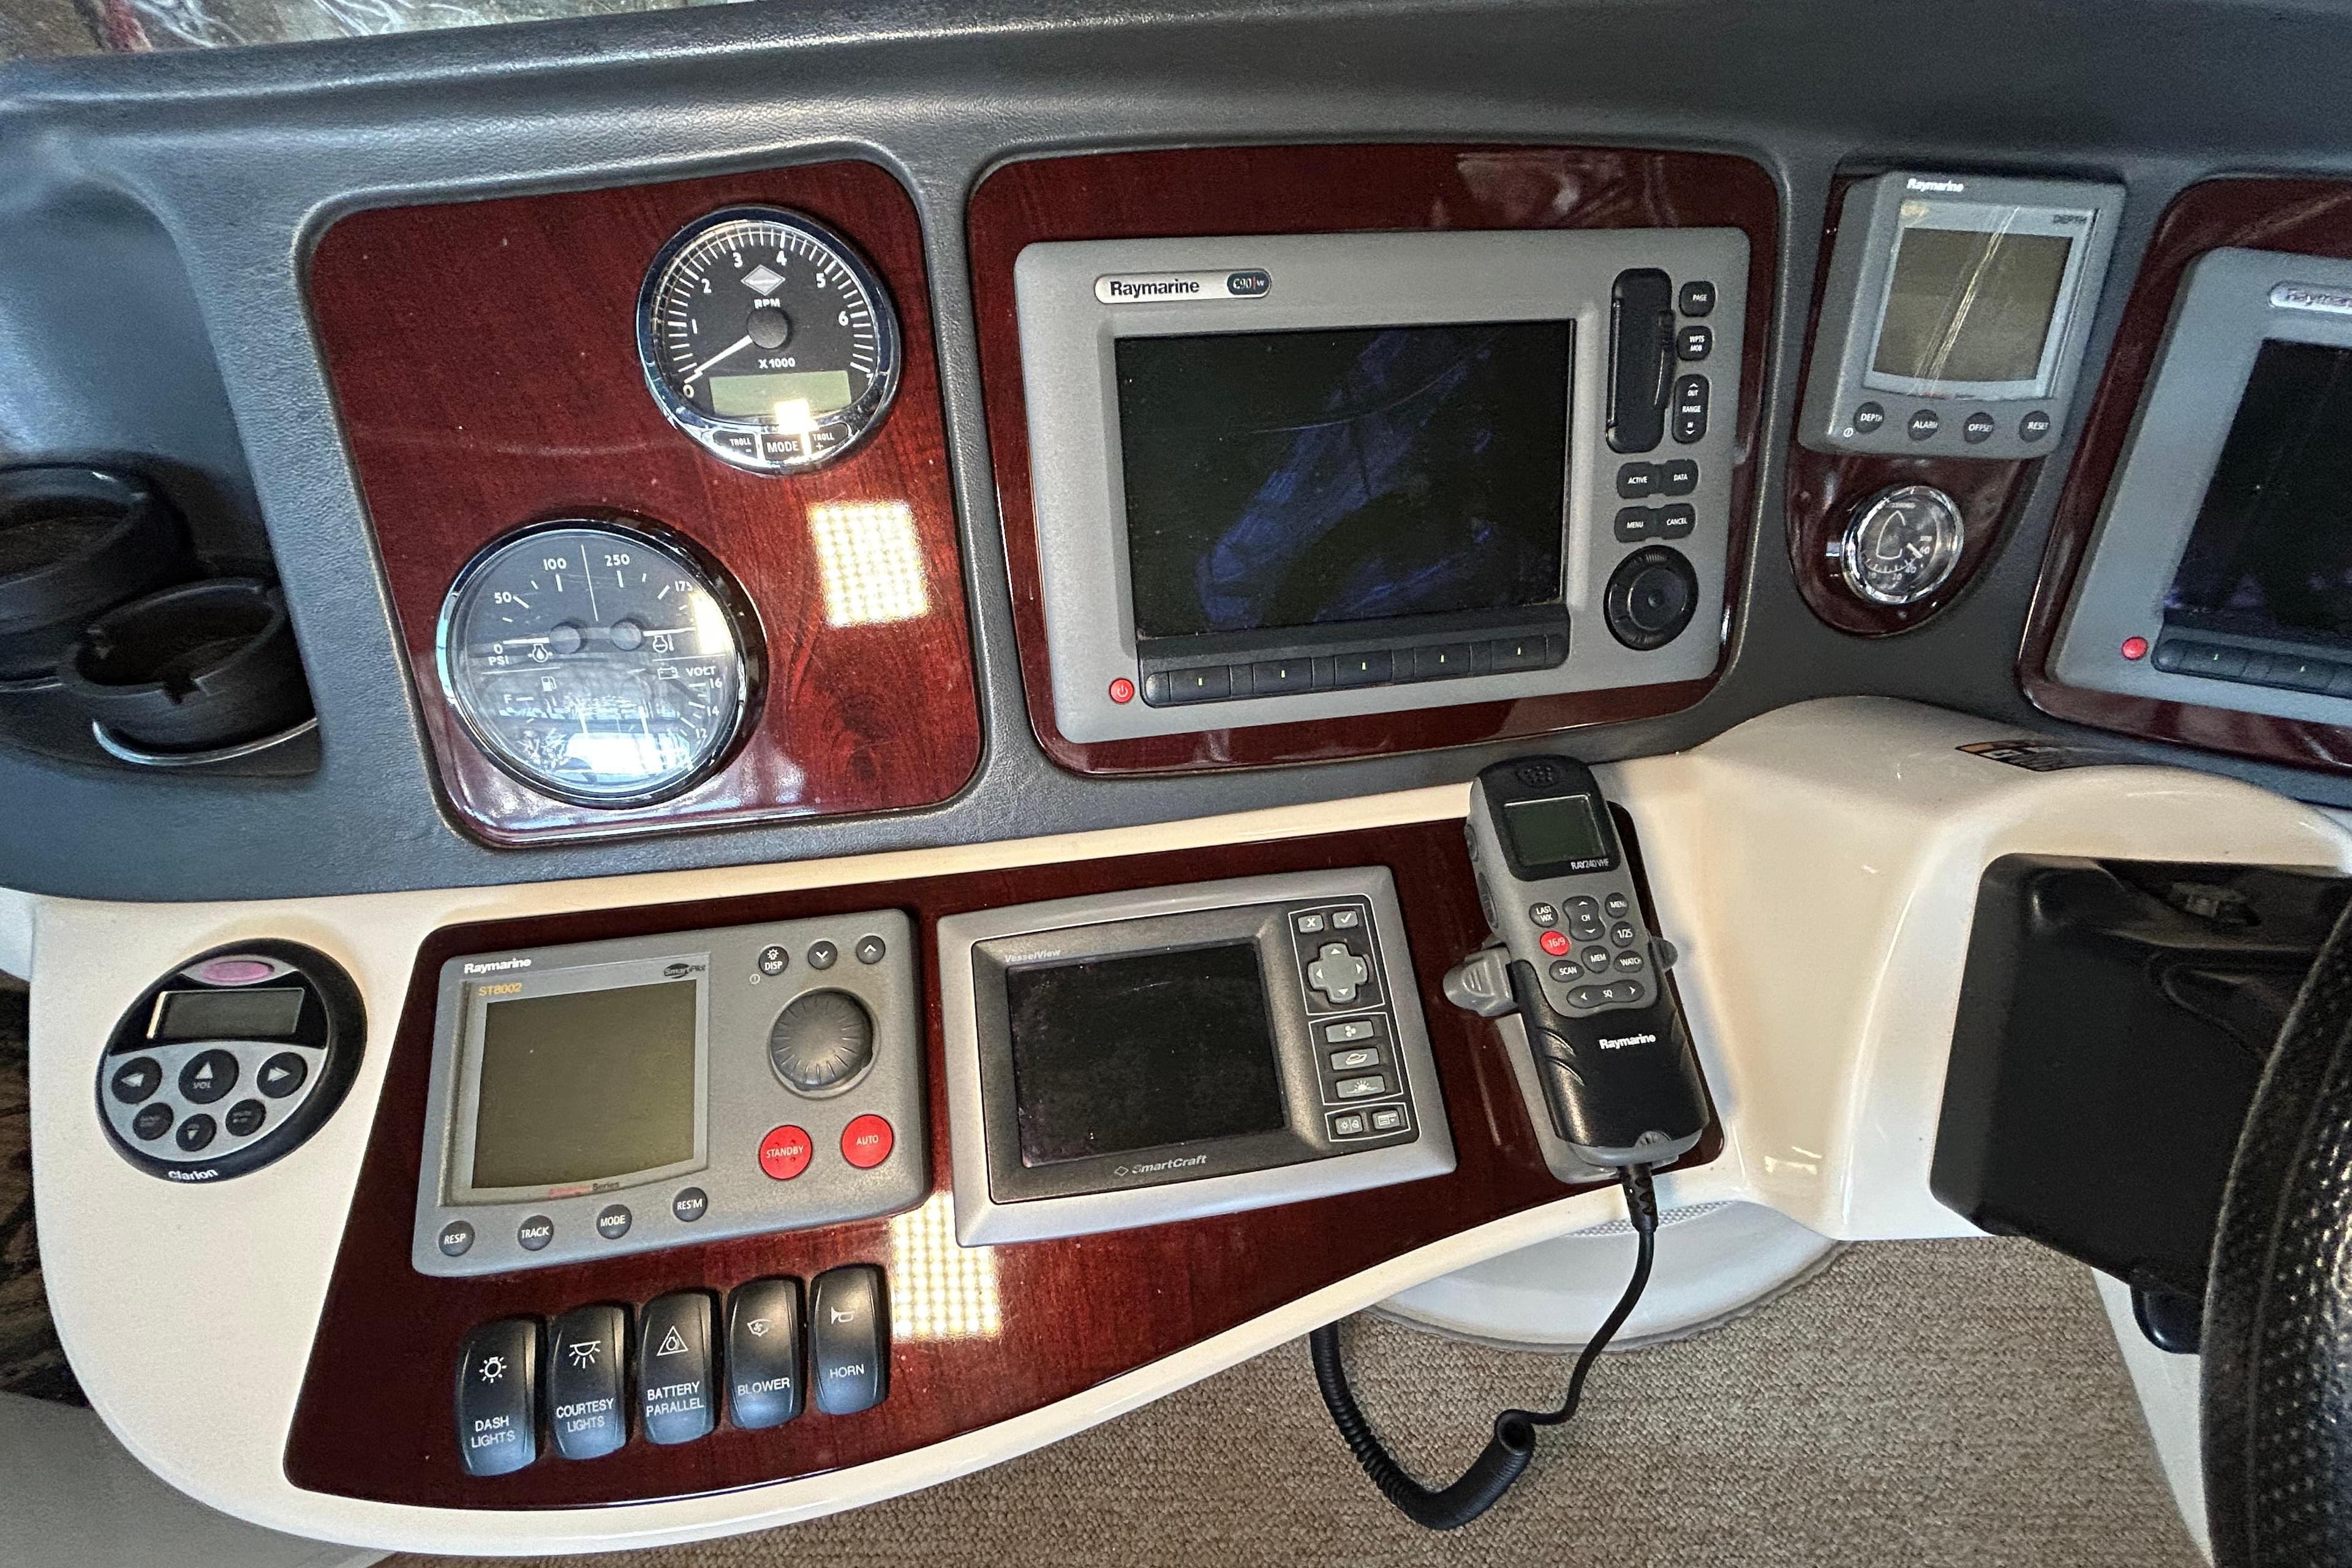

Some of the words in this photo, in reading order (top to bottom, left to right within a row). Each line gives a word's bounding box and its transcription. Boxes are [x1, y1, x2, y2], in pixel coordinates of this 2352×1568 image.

[1907, 178, 1964, 192] Raymarine
[733, 252, 743, 268] 3
[776, 251, 787, 266] 4
[701, 279, 712, 293] 2
[816, 273, 826, 288] 5
[1110, 279, 1200, 298] Raymarine
[754, 298, 780, 309] RPM
[838, 311, 849, 326] 6
[692, 319, 697, 334] 1
[683, 385, 695, 398] 0
[729, 437, 752, 447] TROLL
[813, 432, 834, 441] TROLL
[766, 441, 799, 453] MODE
[543, 557, 567, 571] 100
[605, 554, 630, 567] 250
[674, 580, 693, 592] 175
[494, 592, 512, 604] 50
[493, 644, 503, 655] 0
[488, 655, 509, 666] PSI
[685, 665, 716, 676] VOLT
[710, 678, 722, 688] 16
[504, 694, 512, 704] F
[706, 705, 720, 717] 14
[695, 728, 707, 739] 12
[1536, 906, 1551, 914] LAST
[1548, 937, 1566, 948] 16/9
[1591, 954, 1606, 962] MEM
[1620, 957, 1641, 966] WATCH
[464, 958, 532, 974] Raymarine
[764, 961, 783, 971] DISP
[1559, 967, 1577, 975] SCAN
[478, 982, 522, 996] ST8002
[1599, 1034, 1656, 1050] Raymarine
[856, 1134, 879, 1146] AUTO
[766, 1145, 804, 1158] STANDBY
[1132, 1155, 1207, 1174] SmartCraft
[600, 1215, 626, 1227] MODE
[521, 1226, 549, 1238] TRACK
[444, 1233, 466, 1245] RESP
[829, 1365, 865, 1380] HORN
[647, 1381, 700, 1401] BATTERY
[737, 1377, 791, 1396] BLOWER
[556, 1398, 614, 1419] COURTESY
[646, 1398, 704, 1417] PARALLEL
[474, 1415, 510, 1433] DASH
[567, 1415, 605, 1433] LIGHTS
[470, 1430, 516, 1448] LIGHTS
